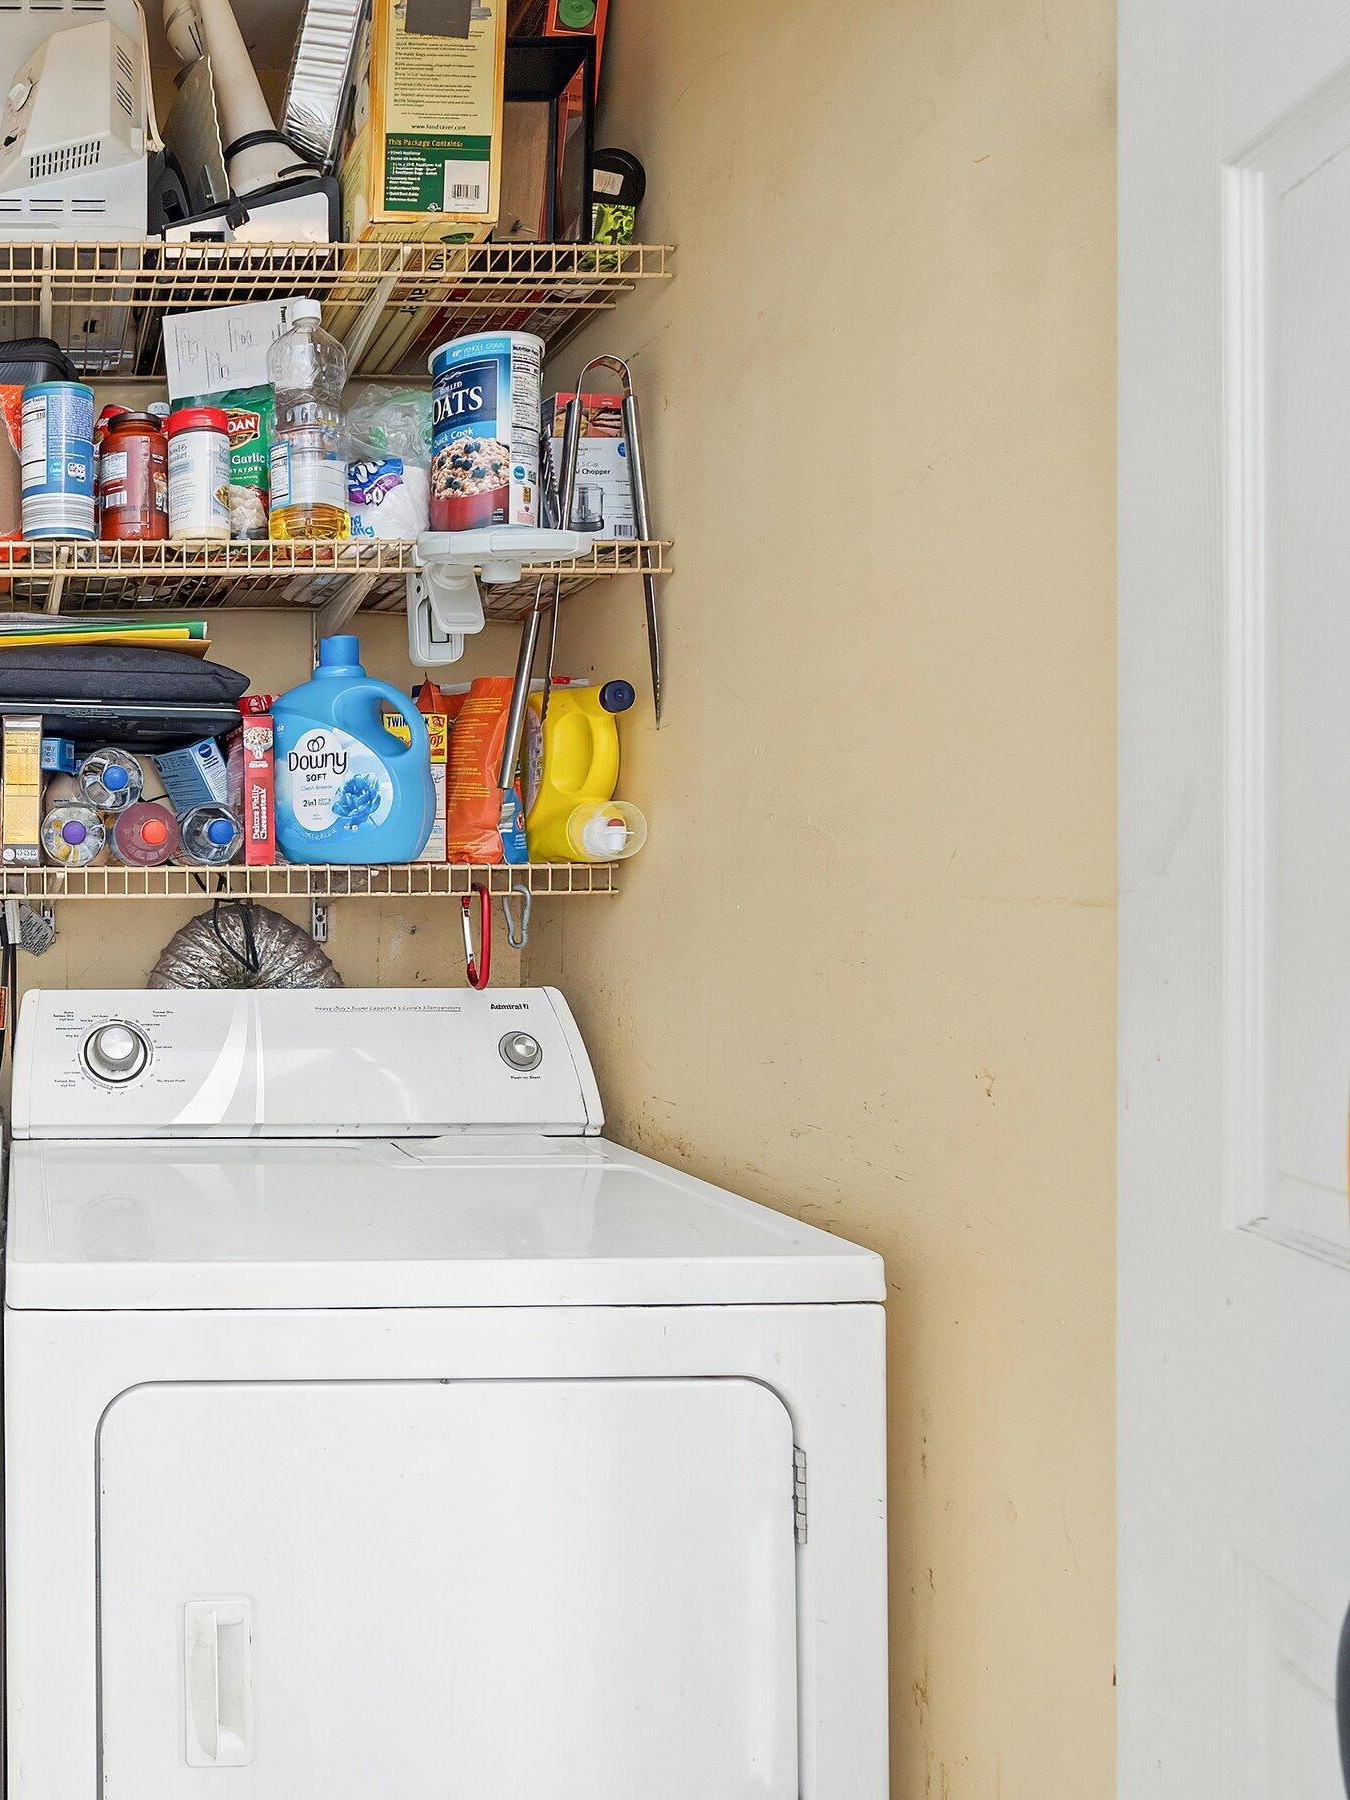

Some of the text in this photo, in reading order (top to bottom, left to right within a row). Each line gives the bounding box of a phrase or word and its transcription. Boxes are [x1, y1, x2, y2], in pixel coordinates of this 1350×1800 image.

[403, 139, 430, 147] Package
[433, 386, 483, 425] OATS
[450, 427, 474, 439] Cook
[231, 453, 265, 464] Garlic
[289, 752, 347, 774] Downy
[306, 773, 327, 782] SOFT
